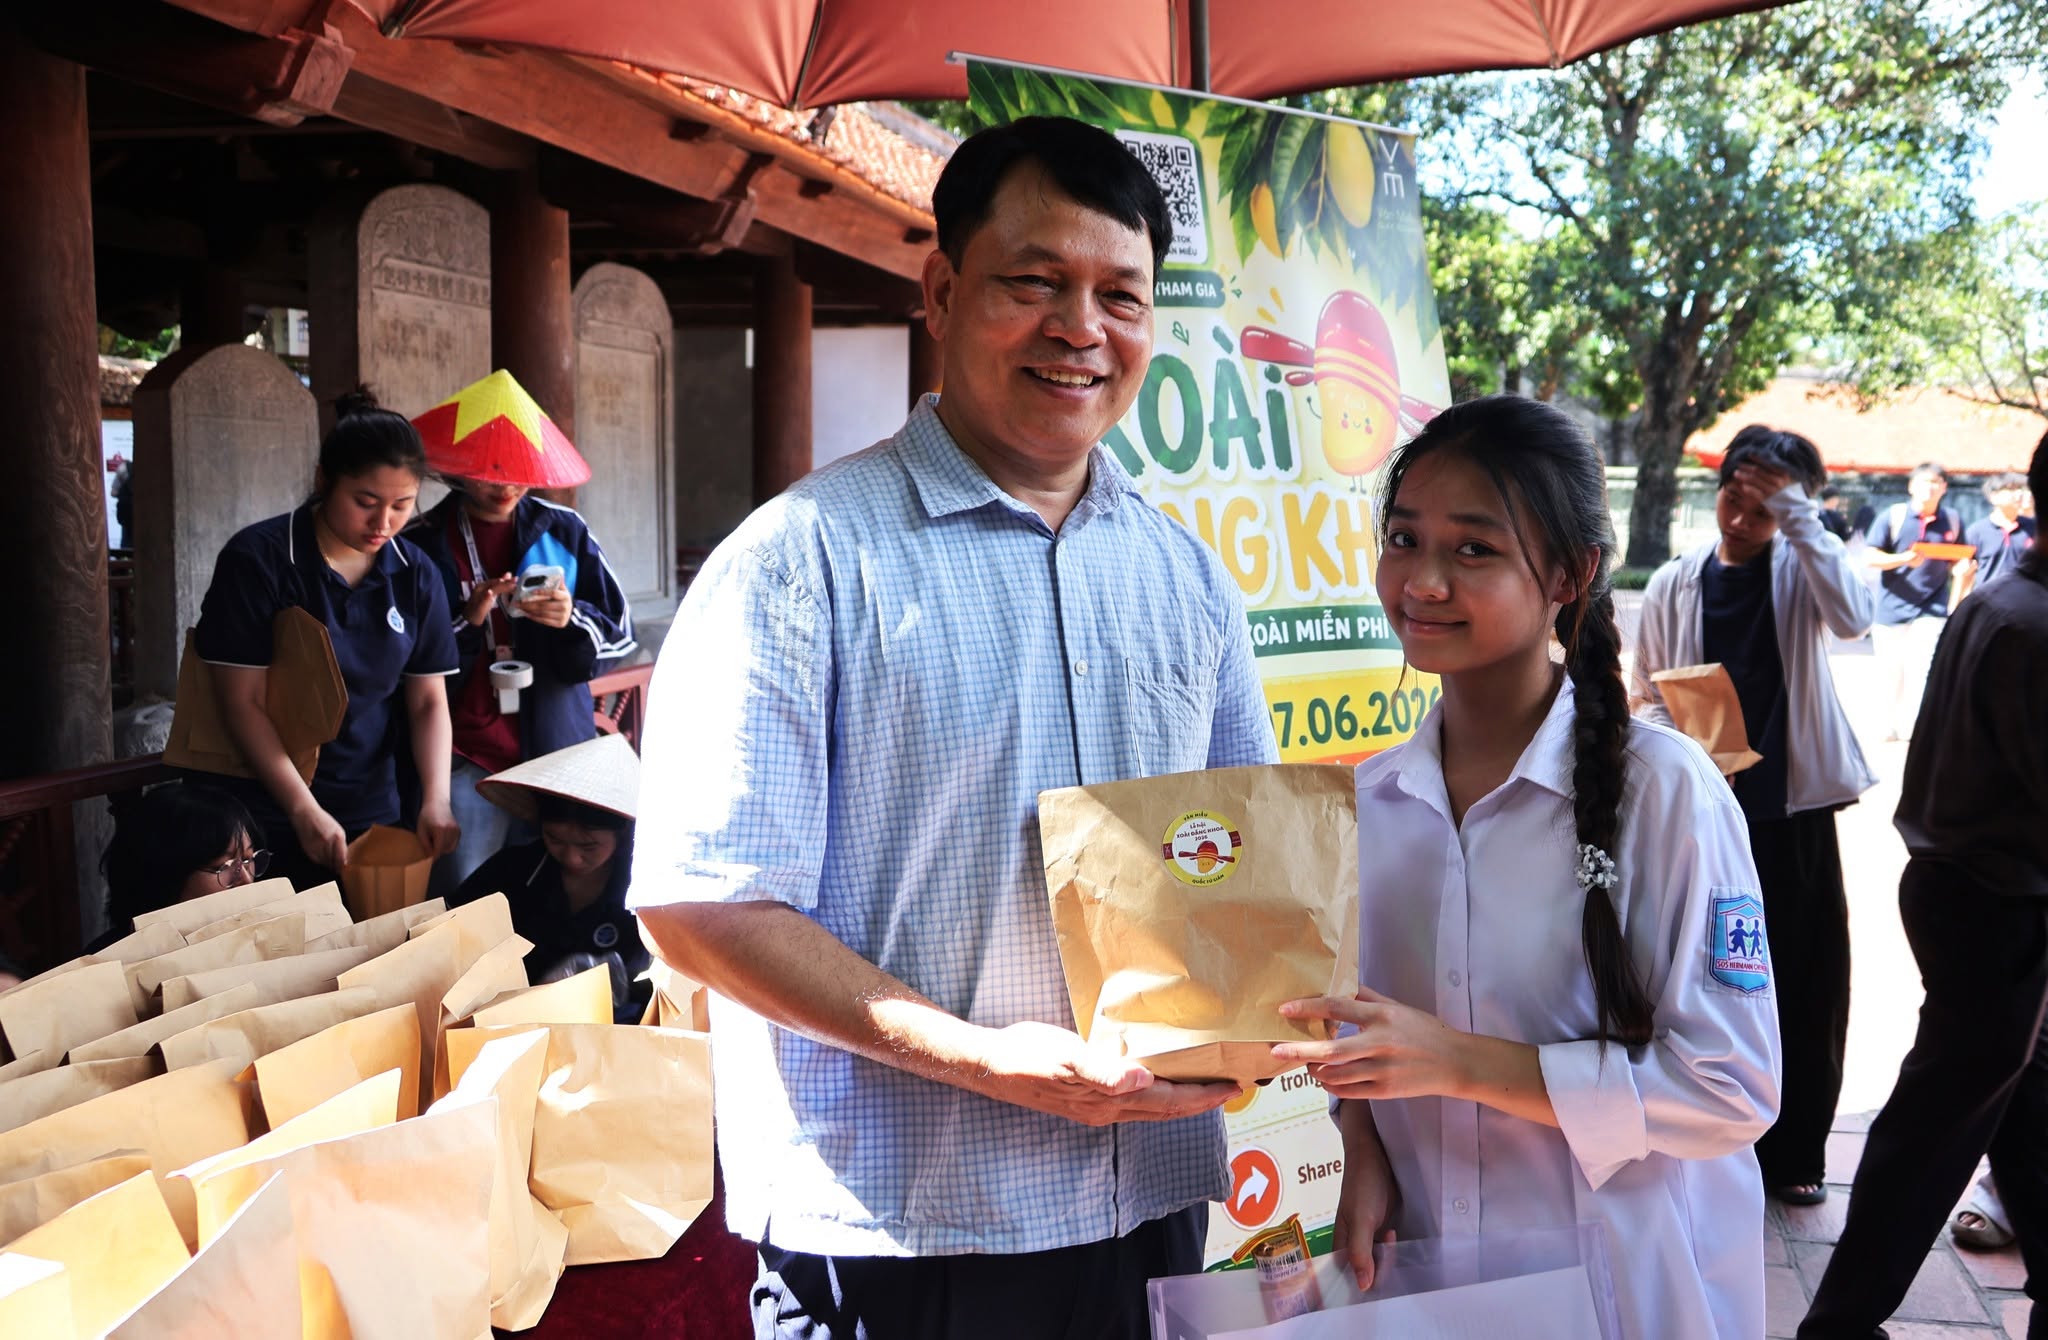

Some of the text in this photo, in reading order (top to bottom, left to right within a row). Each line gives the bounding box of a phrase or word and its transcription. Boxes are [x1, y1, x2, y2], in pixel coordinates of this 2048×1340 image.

[1195, 281, 1217, 298] GIA
[1159, 491, 1377, 594] NG KH
[1295, 609, 1351, 642] MIỄN
[1717, 960, 1729, 968] SOS
[1298, 1159, 1343, 1185] Share
